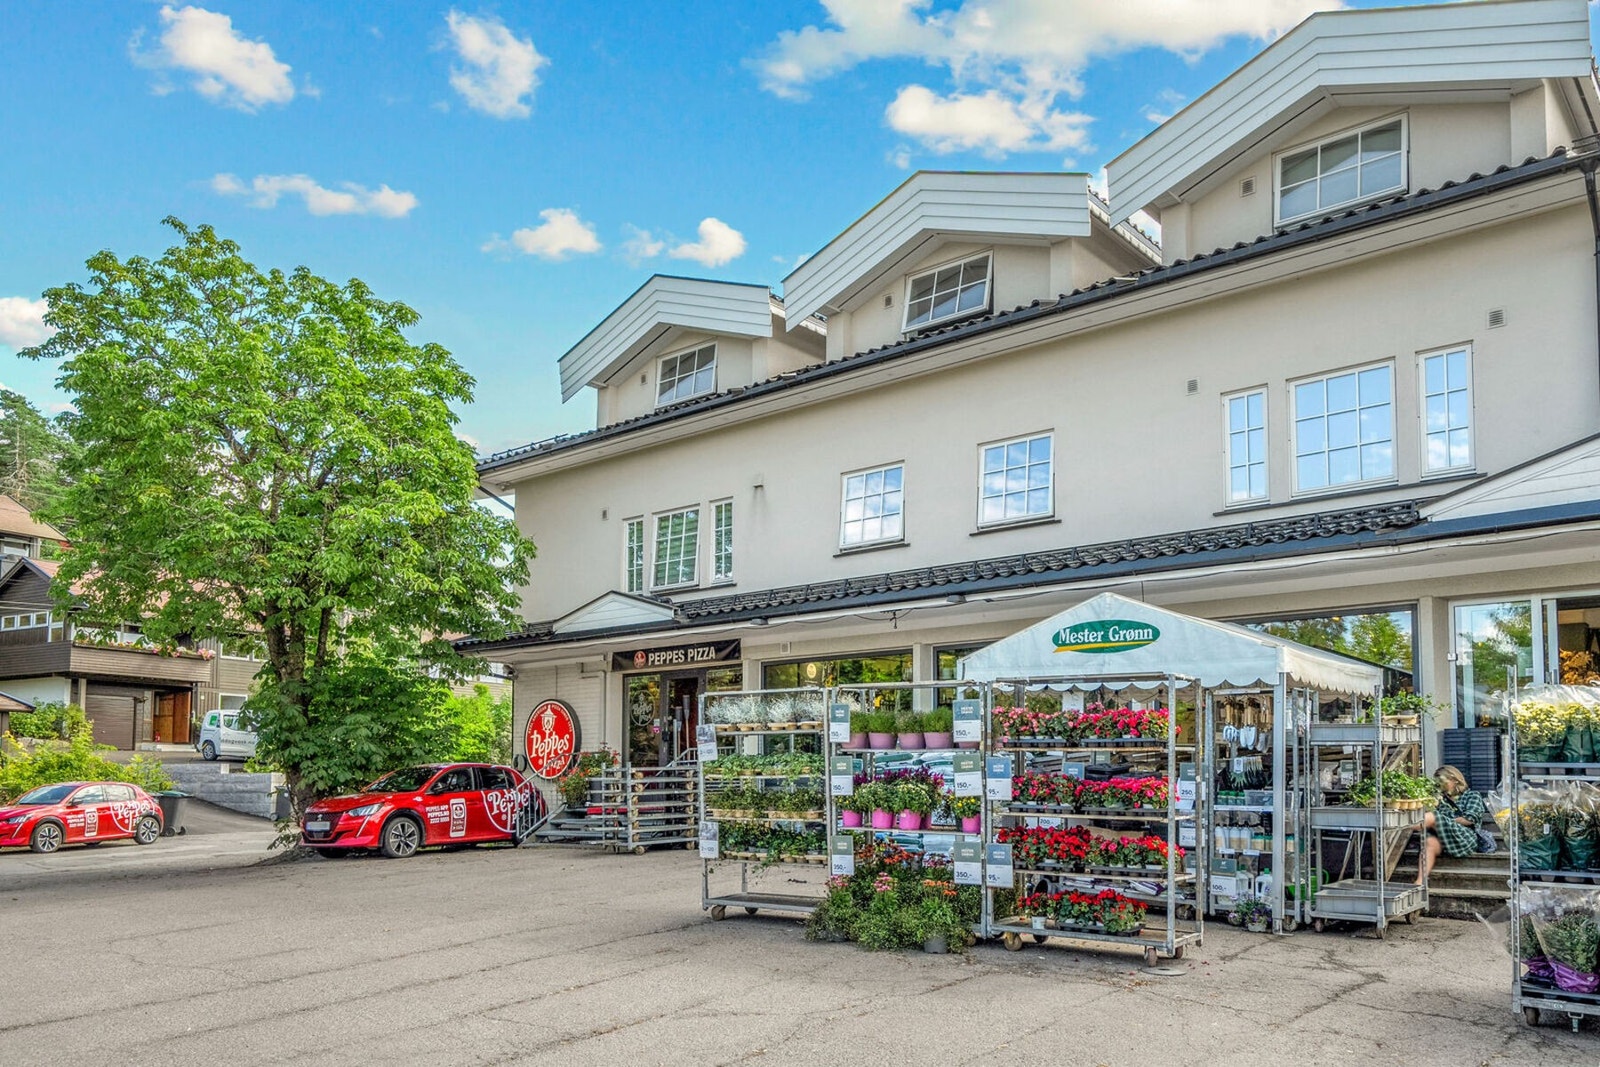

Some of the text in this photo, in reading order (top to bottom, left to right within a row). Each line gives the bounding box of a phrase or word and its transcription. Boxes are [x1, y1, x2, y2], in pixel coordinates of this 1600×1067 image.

[1058, 626, 1153, 644] Mester Grønn
[648, 646, 716, 666] PEPPES PIZZA
[530, 730, 570, 758] Peppes
